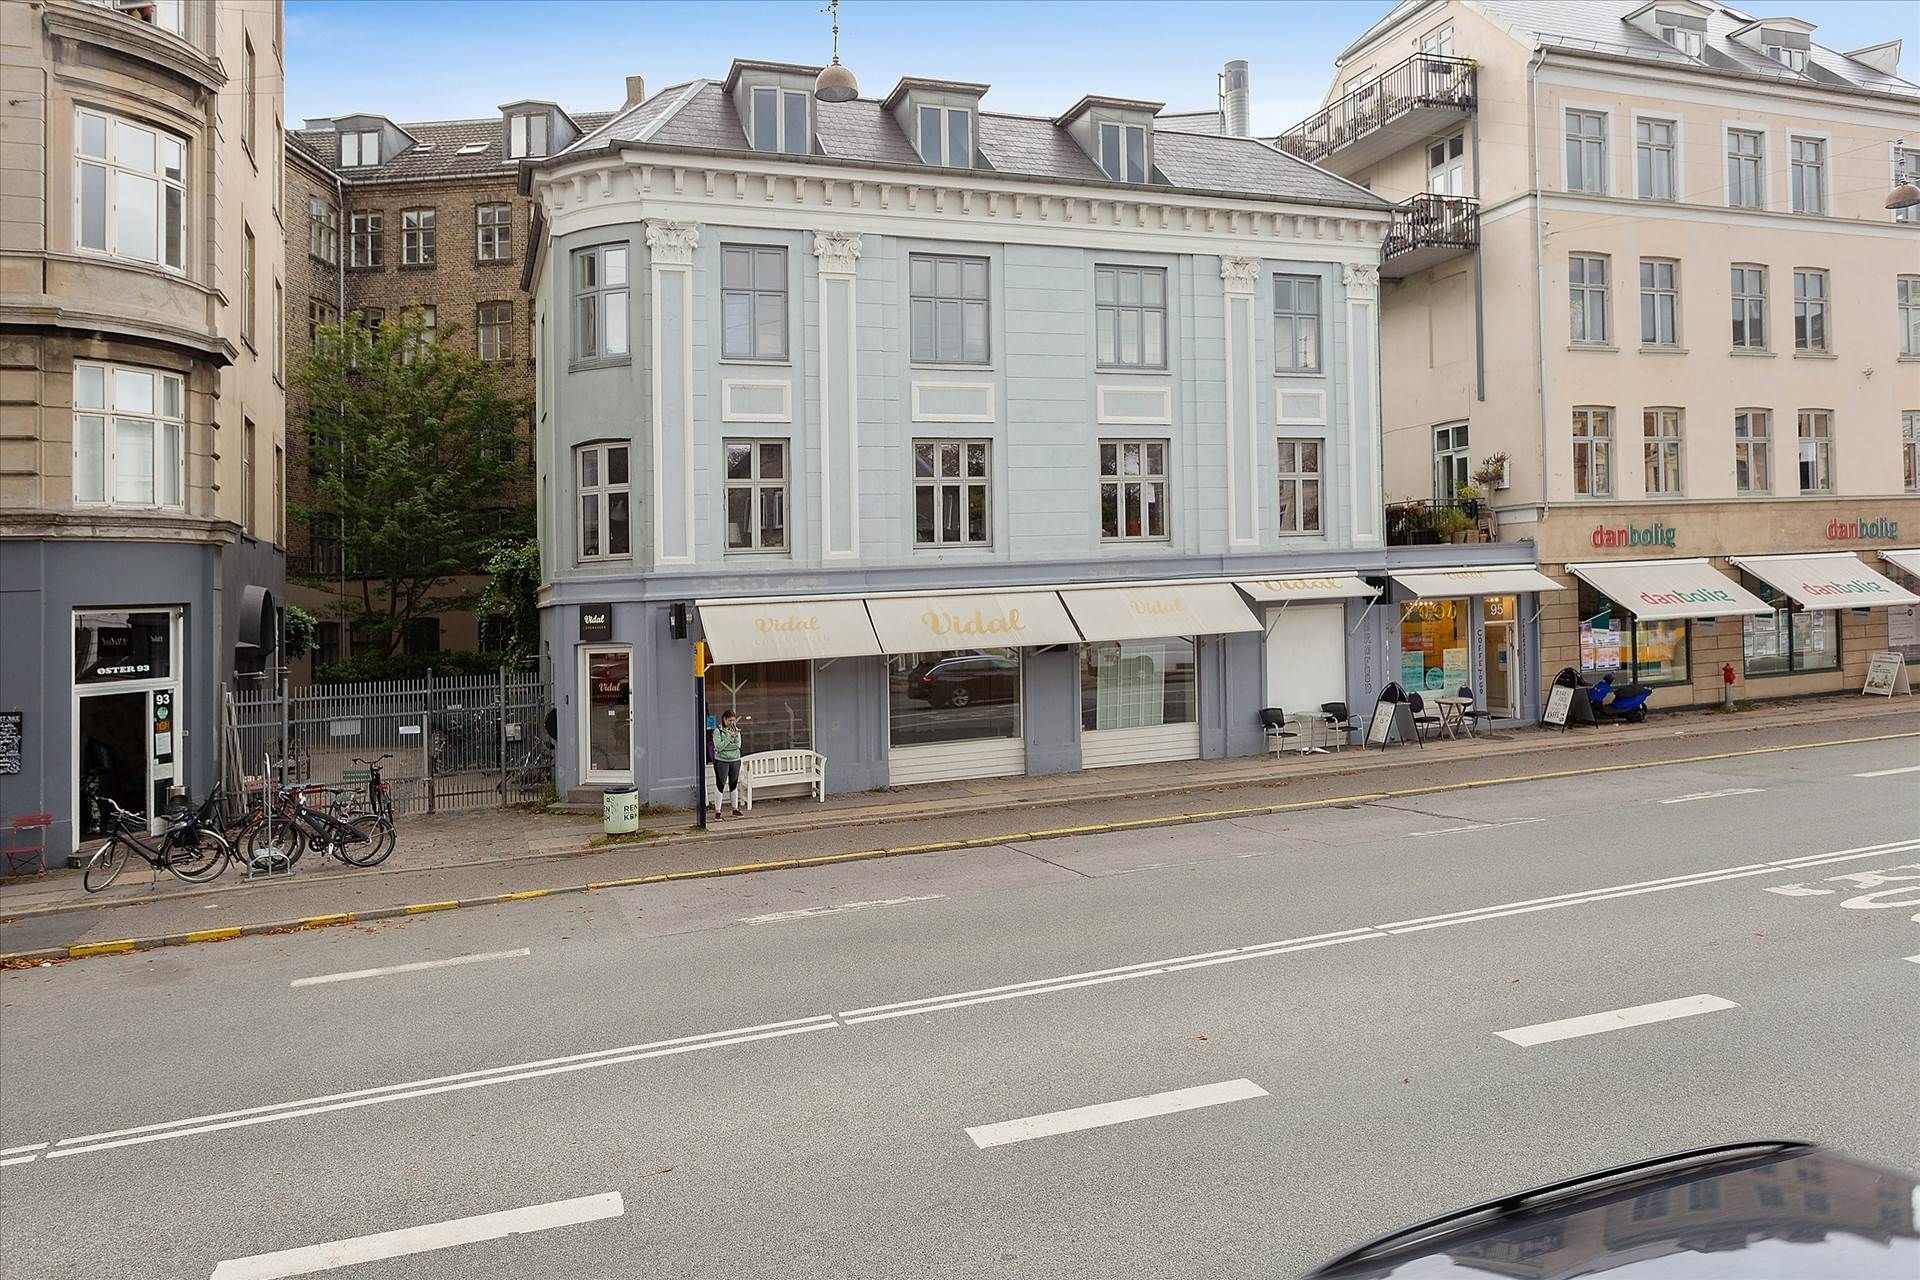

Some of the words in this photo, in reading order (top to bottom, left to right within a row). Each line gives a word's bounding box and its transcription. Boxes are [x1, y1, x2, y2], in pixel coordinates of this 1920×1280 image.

[1591, 522, 1677, 548] danbolig
[1826, 517, 1898, 541] danbolig
[1803, 580, 1890, 595] danbolig
[1639, 588, 1736, 604] danbolig
[1490, 603, 1504, 615] 95
[584, 614, 605, 624] Vidal
[754, 616, 818, 632] Vidal
[922, 608, 1026, 635] Vidal
[137, 664, 150, 673] 93
[599, 682, 621, 692] Vidal
[156, 694, 170, 705] 93
